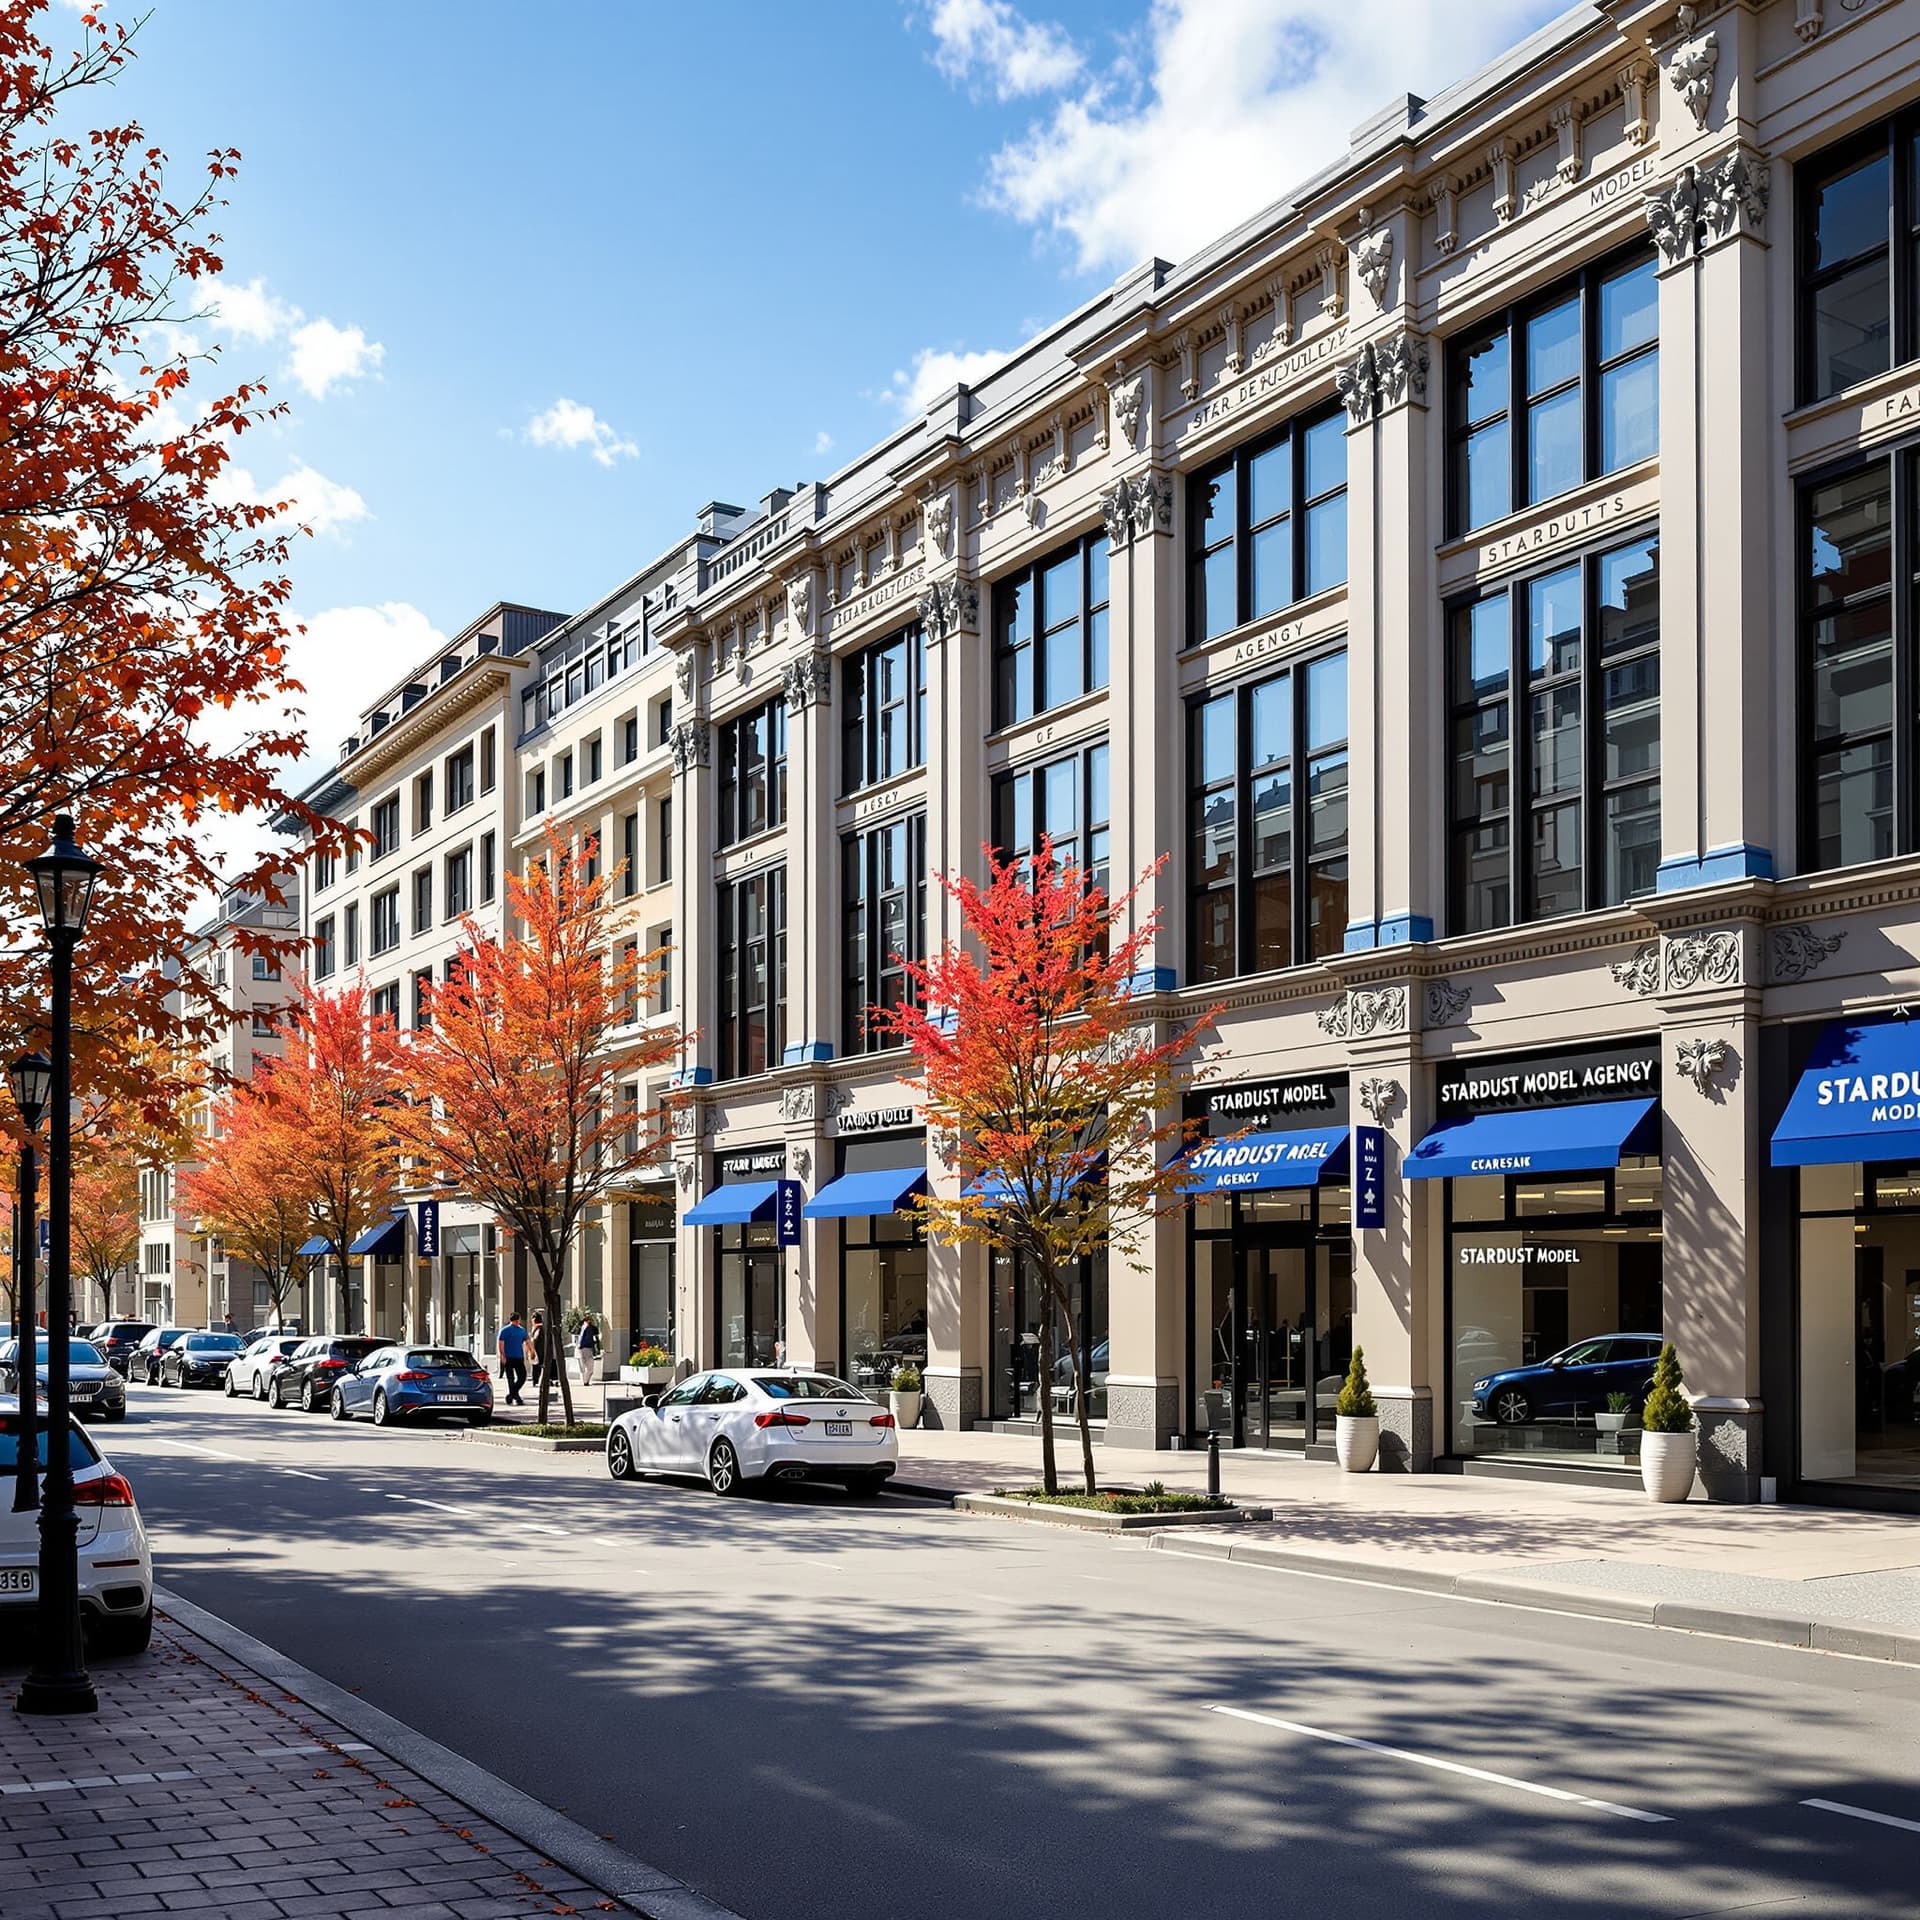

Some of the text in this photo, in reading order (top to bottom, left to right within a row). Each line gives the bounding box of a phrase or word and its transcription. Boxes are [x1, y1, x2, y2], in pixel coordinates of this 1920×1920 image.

[1590, 160, 1654, 207] MODEL
[1886, 391, 1920, 418] FA
[1488, 497, 1624, 563] STARDUTTS
[1036, 726, 1054, 744] OF
[1210, 1084, 1327, 1112] STARDUST MODEL
[1441, 1076, 1520, 1102] STARDUST
[1523, 1069, 1578, 1094] MODEL
[1190, 1143, 1289, 1169] STARDUST
[1216, 1172, 1260, 1187] AGENCY
[1460, 1247, 1581, 1264] STARDUST MODEL
